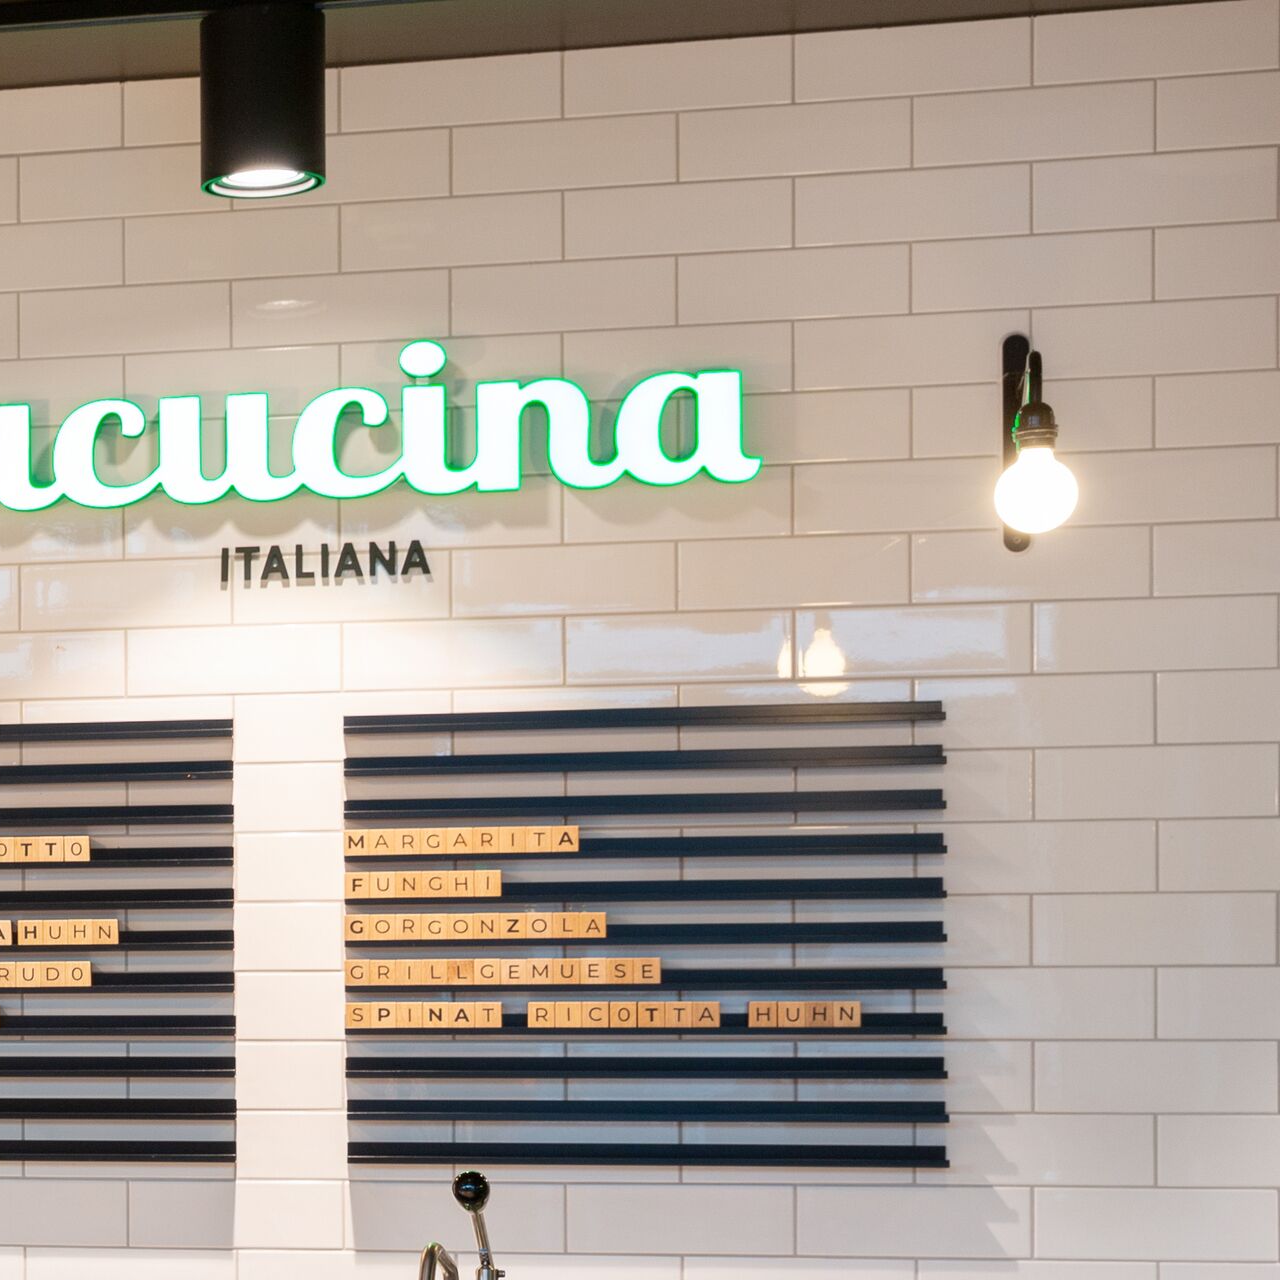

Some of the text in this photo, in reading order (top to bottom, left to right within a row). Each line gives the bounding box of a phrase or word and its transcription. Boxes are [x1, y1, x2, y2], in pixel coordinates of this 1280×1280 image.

[220, 540, 430, 583] ITALIANA
[348, 831, 574, 849] MARGARITA
[351, 875, 491, 893] FUNGHI
[25, 925, 111, 940] HUHN
[350, 918, 601, 935] GORGONZOLA
[350, 963, 655, 980] GRILLGEMUESE
[352, 1005, 854, 1022] SPINAT RICOTTA HUHN
